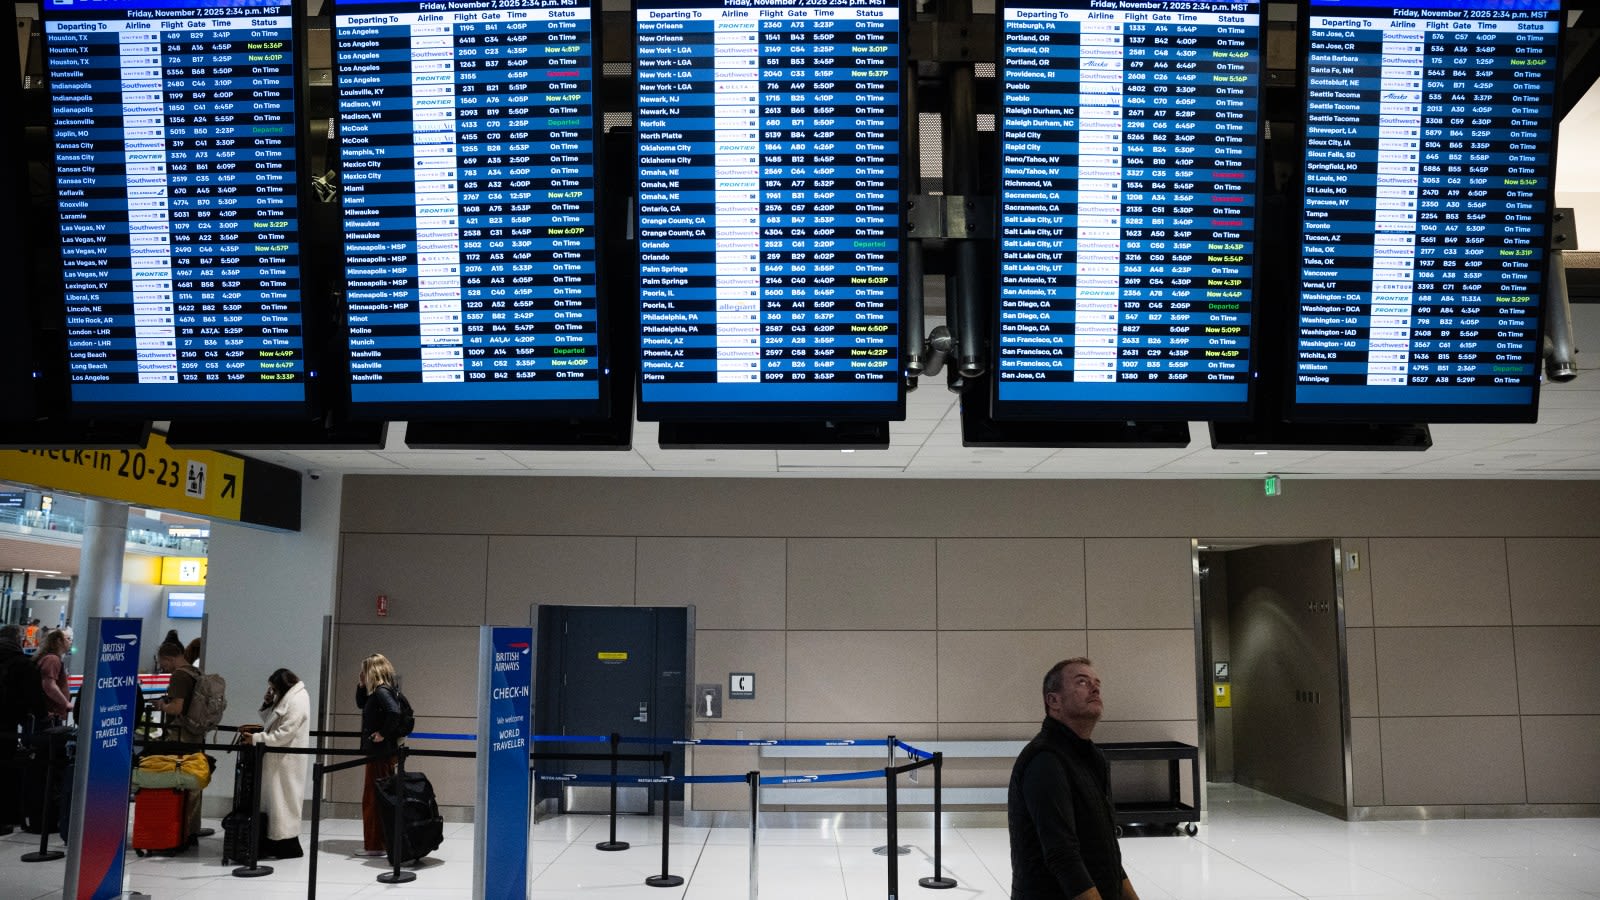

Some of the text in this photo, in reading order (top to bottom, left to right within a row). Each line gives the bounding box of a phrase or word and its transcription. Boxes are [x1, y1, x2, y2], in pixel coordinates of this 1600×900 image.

[1393, 9, 1420, 17] Friday,
[348, 17, 387, 25] Departing
[454, 13, 477, 21] Flight
[19, 449, 179, 487] eck-in 20-23
[102, 643, 125, 652] BRITISH
[101, 652, 124, 662] AIRWAYS
[496, 652, 519, 661] BRITISH
[495, 662, 519, 672] AIRWAYS
[98, 676, 134, 689] CHECK-IN
[494, 686, 529, 699] CHECK-IN
[101, 717, 122, 727] WORLD
[505, 715, 524, 723] welcome
[96, 727, 128, 739] TRAVELLER
[499, 729, 520, 739] WORLD
[102, 738, 117, 748] PLUS
[493, 739, 524, 751] TRAVELLER
